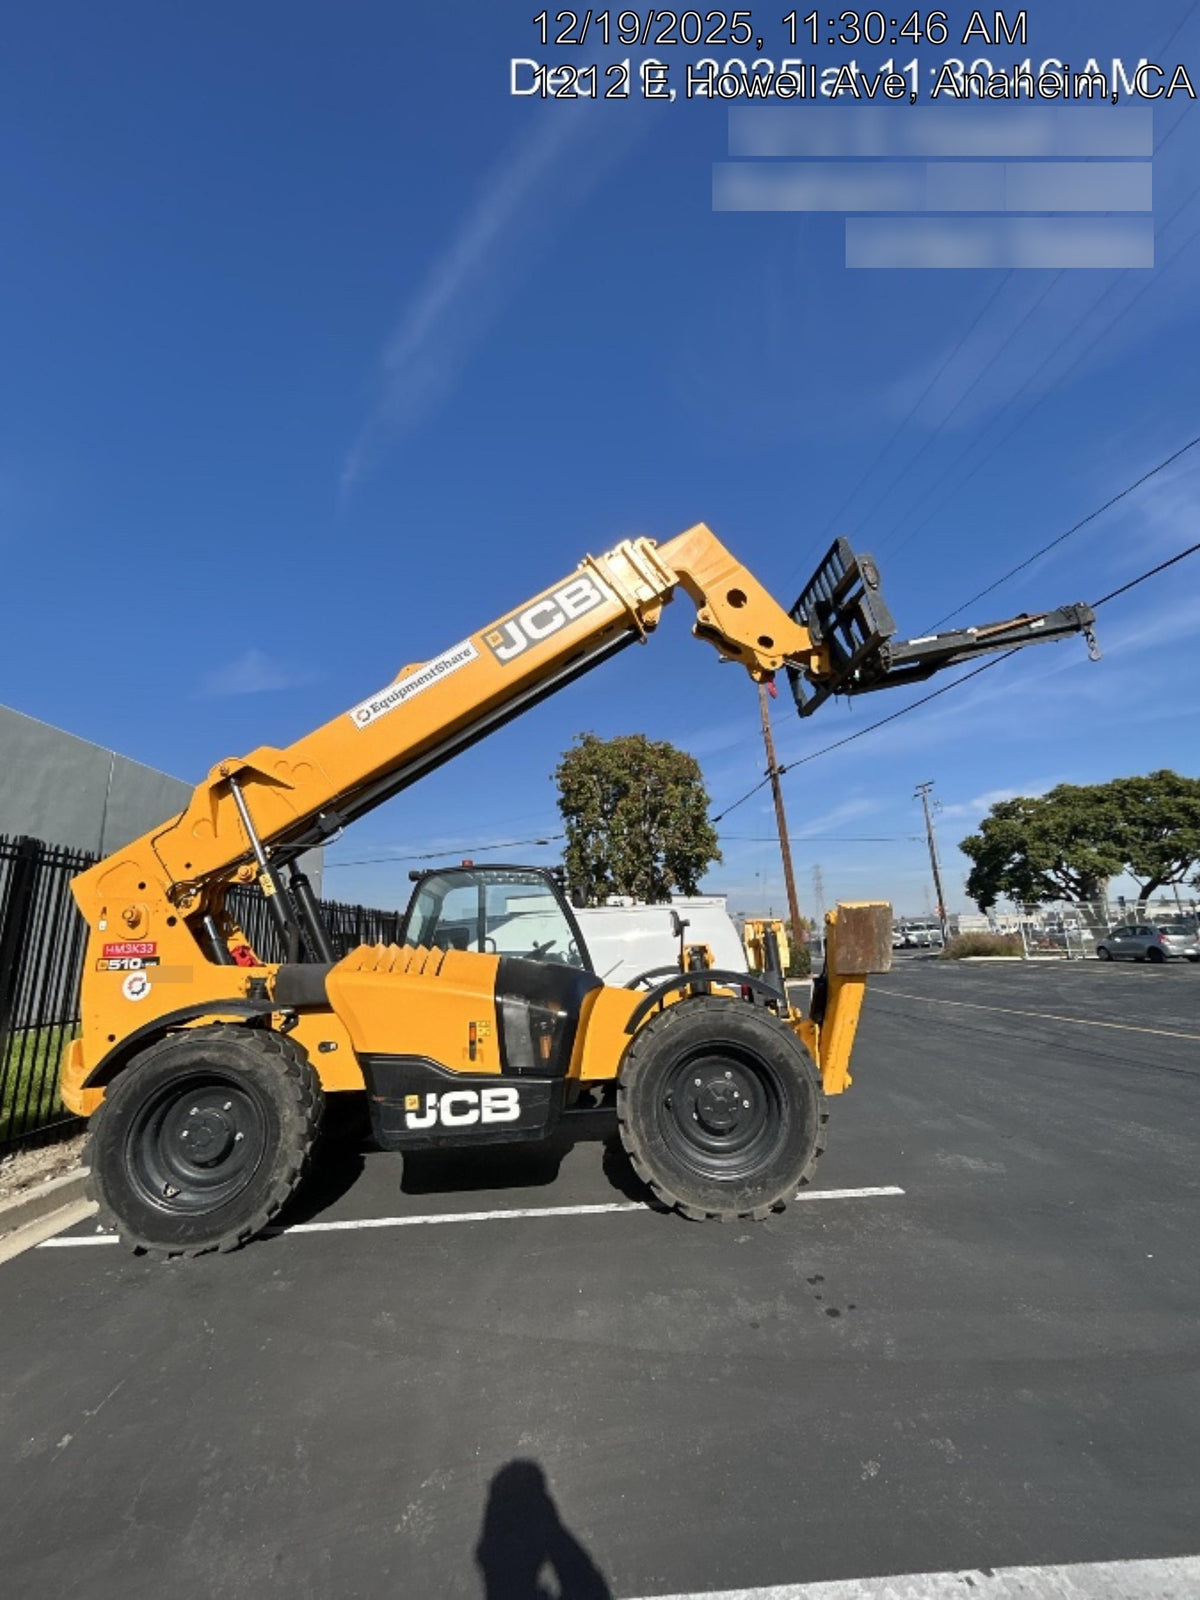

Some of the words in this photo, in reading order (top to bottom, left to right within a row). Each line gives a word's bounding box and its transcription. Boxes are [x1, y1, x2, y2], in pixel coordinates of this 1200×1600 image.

[494, 577, 603, 661] JCB
[370, 646, 472, 716] EquipmentShare
[108, 957, 142, 970] 510
[405, 1087, 521, 1130] JCB
